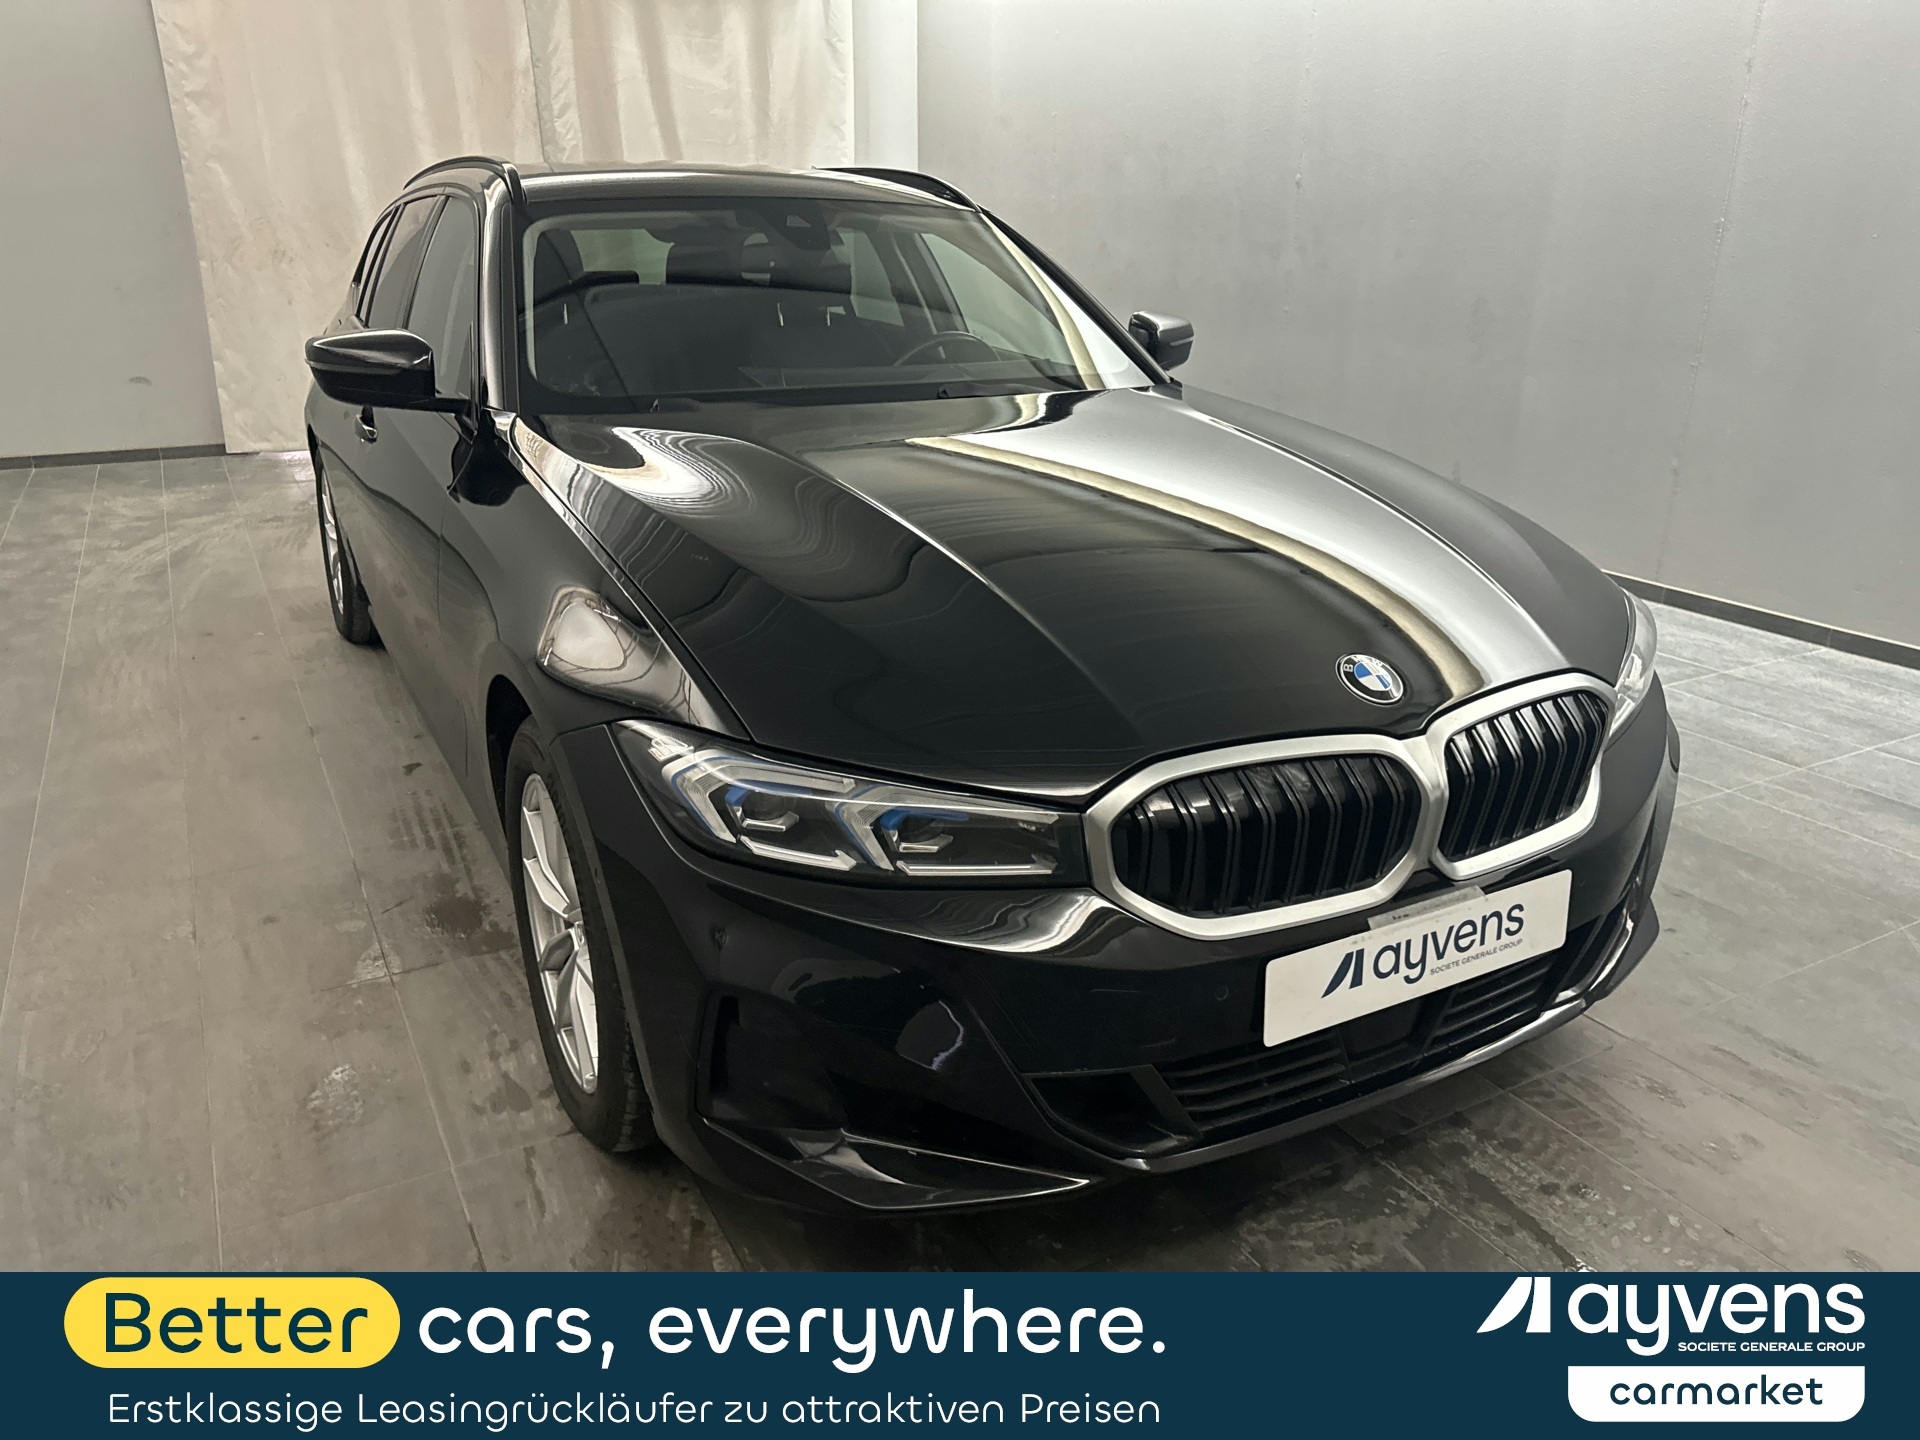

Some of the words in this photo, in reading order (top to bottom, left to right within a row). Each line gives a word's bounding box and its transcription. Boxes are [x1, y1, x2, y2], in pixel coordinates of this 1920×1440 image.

[1373, 904, 1524, 984] ayvens
[1430, 960, 1460, 975] SOCIETE
[1461, 946, 1498, 965] GENERALE
[1498, 938, 1524, 952] GROUP
